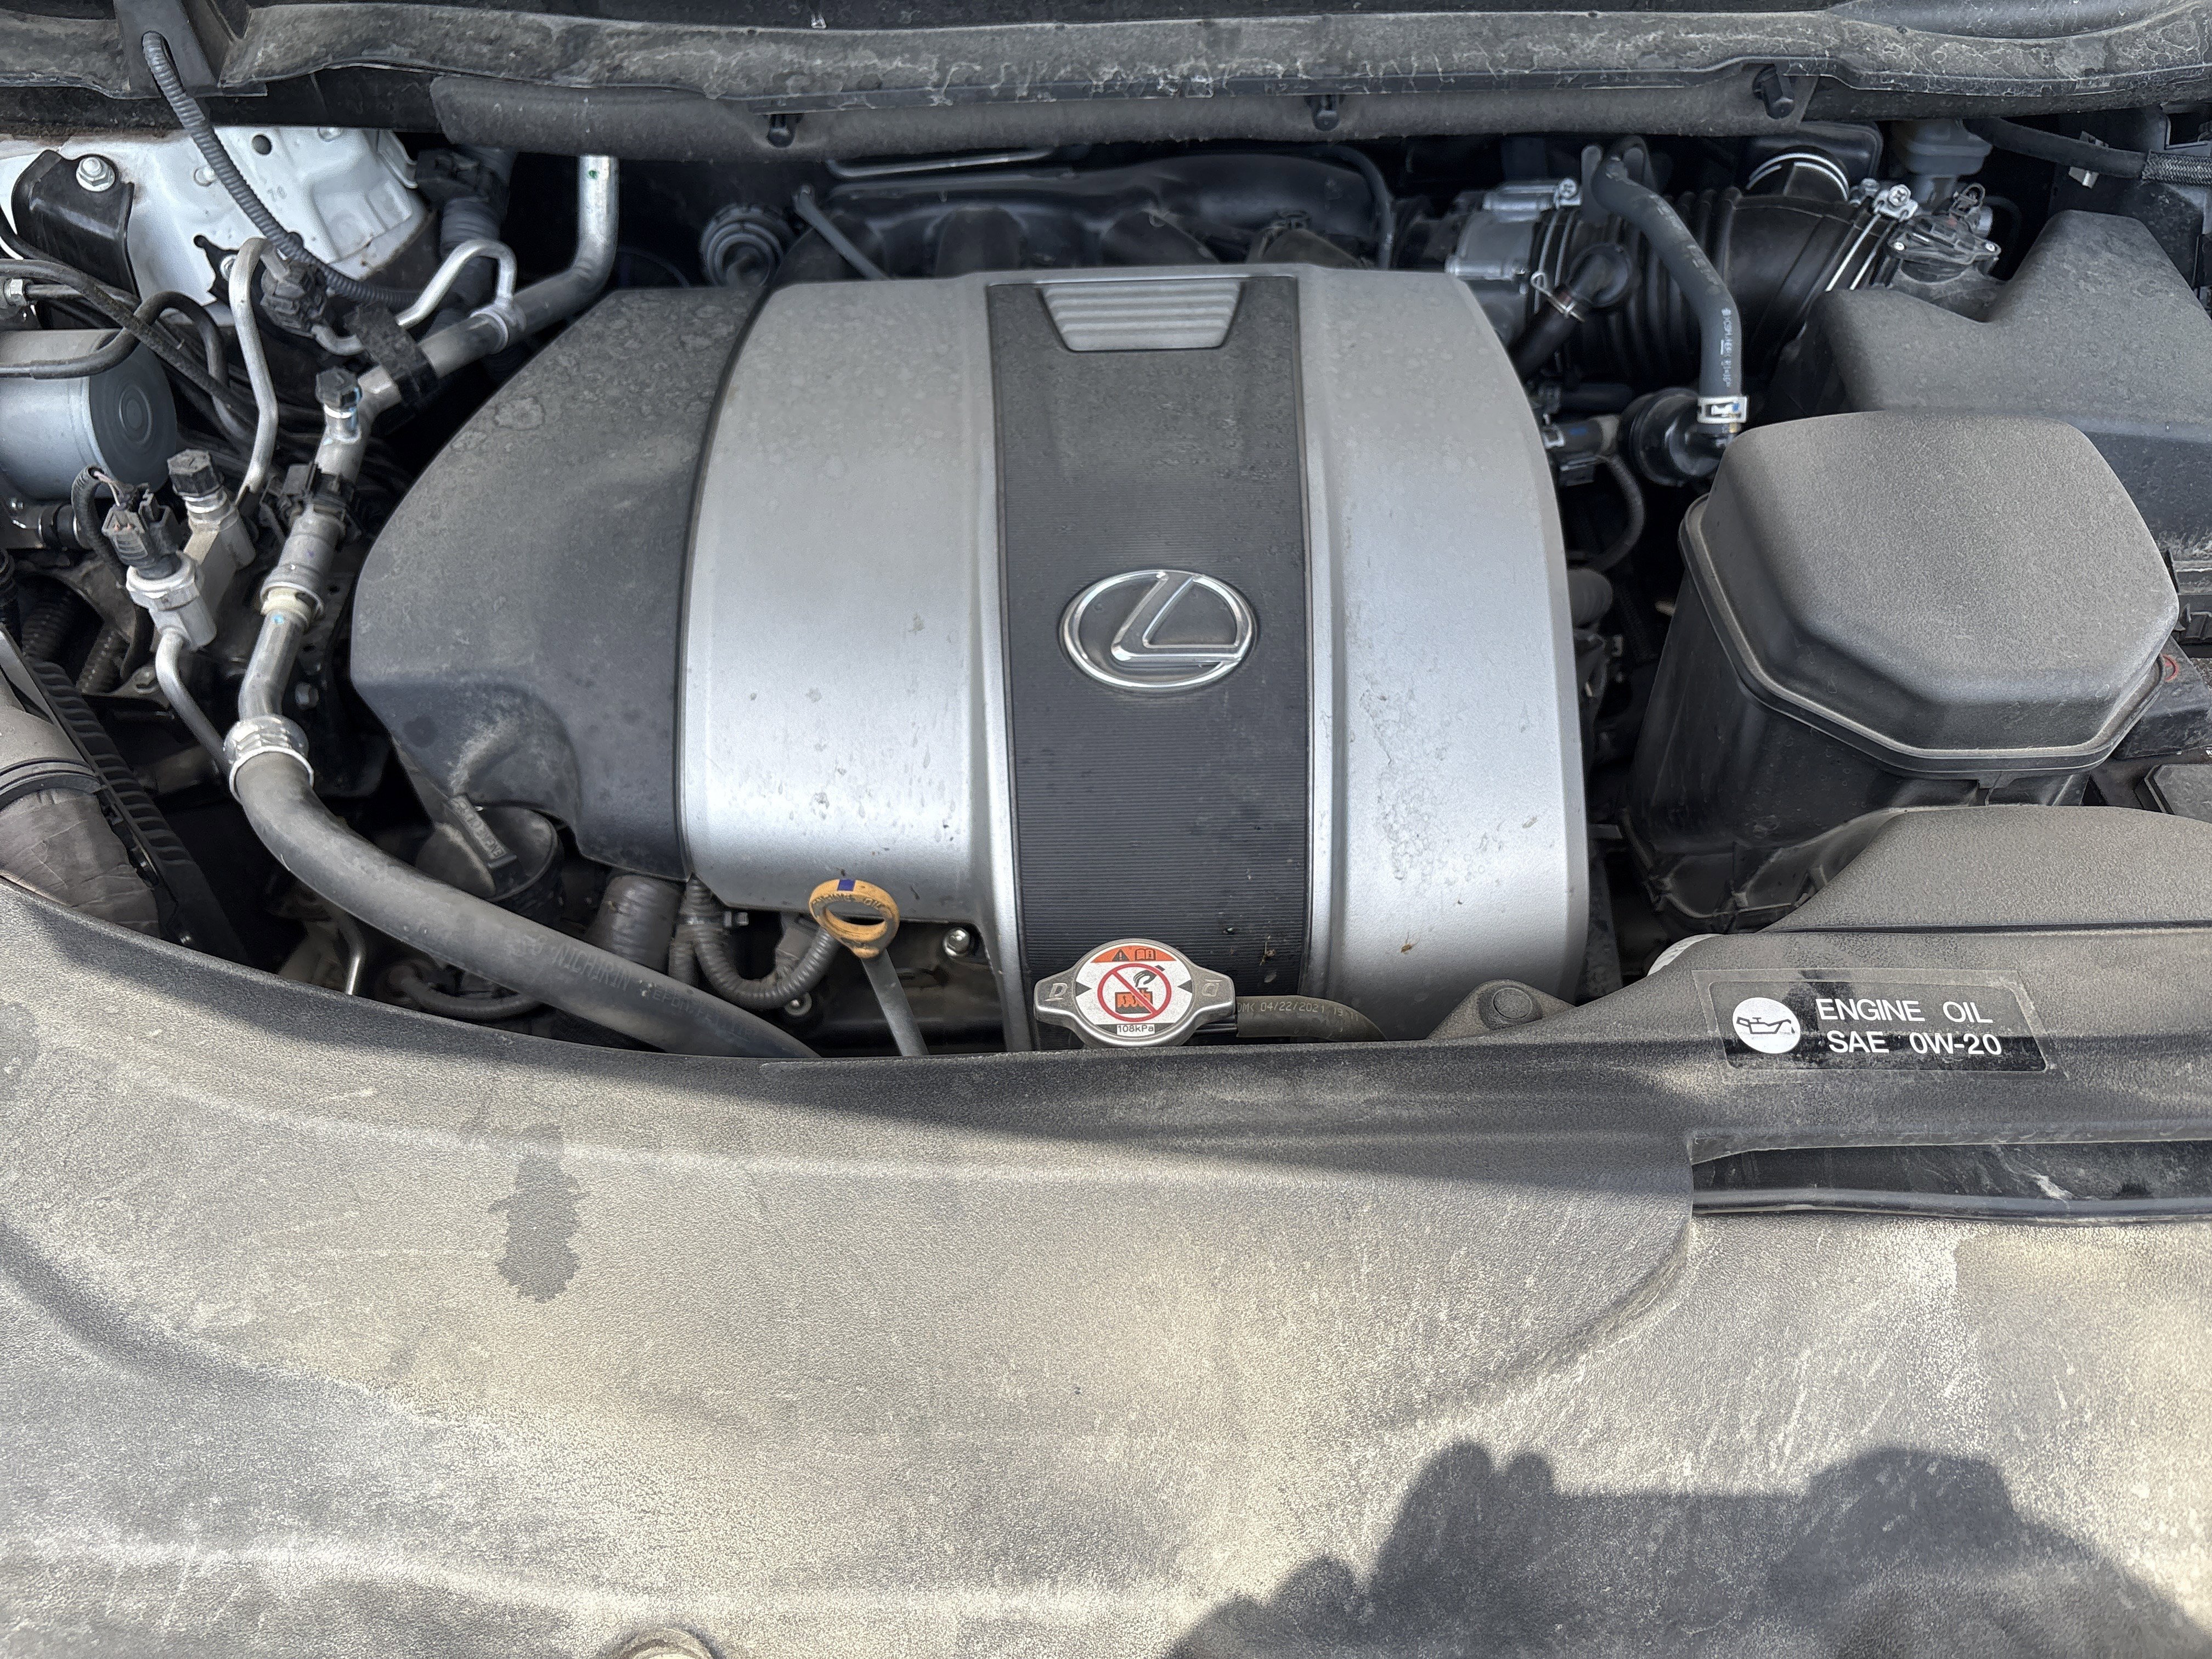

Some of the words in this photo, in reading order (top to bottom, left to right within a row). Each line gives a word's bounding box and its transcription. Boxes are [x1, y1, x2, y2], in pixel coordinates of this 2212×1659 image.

[1260, 1001, 1325, 1014] 04/22/2021
[1815, 998, 1926, 1022] ENGINE
[1942, 1001, 1994, 1024] OIL
[1118, 1024, 1154, 1032] 108kPa
[1827, 1030, 1889, 1053] SAE
[1909, 1032, 2002, 1056] 0W-20
